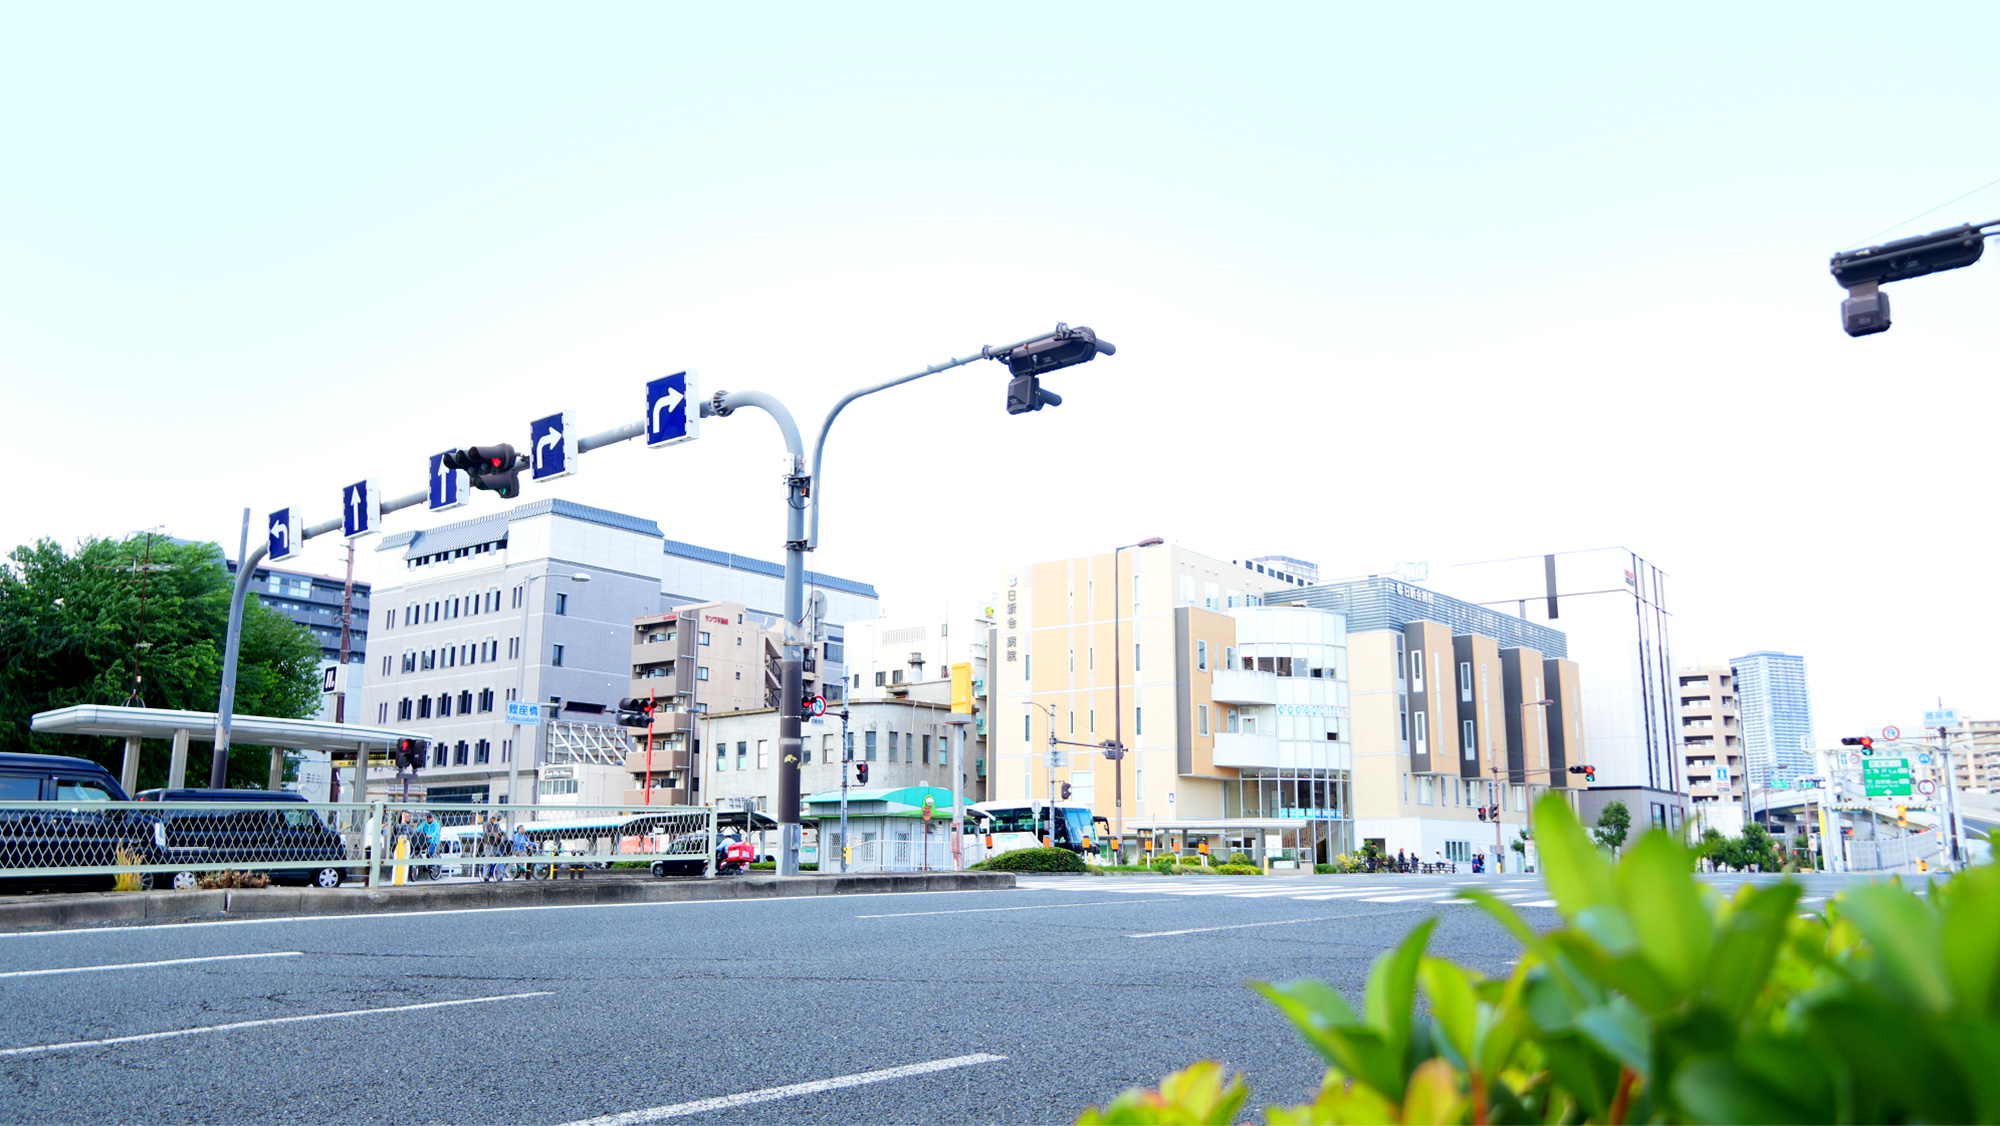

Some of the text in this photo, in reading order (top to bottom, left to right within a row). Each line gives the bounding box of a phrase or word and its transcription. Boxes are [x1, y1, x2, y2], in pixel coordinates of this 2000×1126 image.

[1007, 589, 1018, 662] 日新会病院
